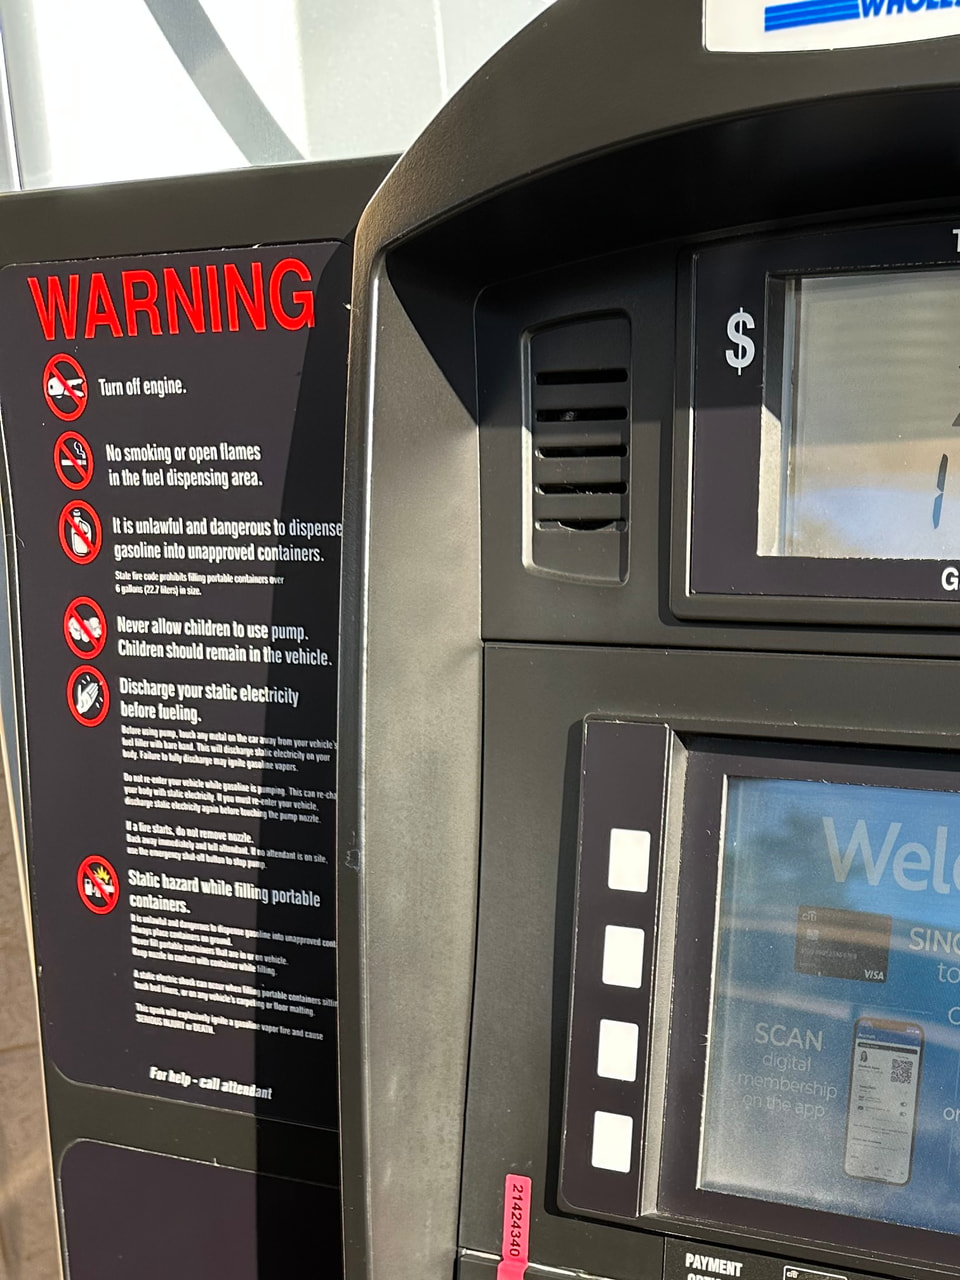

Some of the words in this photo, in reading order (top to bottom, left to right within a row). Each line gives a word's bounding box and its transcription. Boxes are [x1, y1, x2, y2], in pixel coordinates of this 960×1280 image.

[27, 257, 316, 340] WARNING
[725, 306, 754, 375] $
[97, 378, 123, 396] Turn
[125, 377, 140, 395] off
[142, 375, 186, 398] engine.
[105, 443, 122, 461] No
[123, 443, 171, 464] smoking
[173, 446, 186, 460] or
[188, 445, 217, 464] open
[219, 442, 261, 460] flames
[108, 468, 120, 485] in
[121, 468, 140, 486] the
[141, 468, 164, 485] fuel
[166, 467, 229, 489] dispensing
[231, 471, 262, 486] area.
[116, 615, 149, 633] Never
[150, 617, 182, 634] allow
[183, 618, 230, 636] children
[232, 620, 244, 637] to
[246, 624, 268, 638] use
[271, 625, 308, 643] pump.
[119, 676, 175, 700] Discharge
[176, 683, 203, 700] your
[204, 682, 237, 700] static
[239, 684, 298, 707] electricity
[119, 699, 156, 719] before
[157, 702, 202, 725] fueling.
[937, 962, 960, 983] to
[755, 1022, 823, 1051] SCAN
[509, 1183, 524, 1258] 21424340
[684, 1252, 743, 1277] PAYMENT
